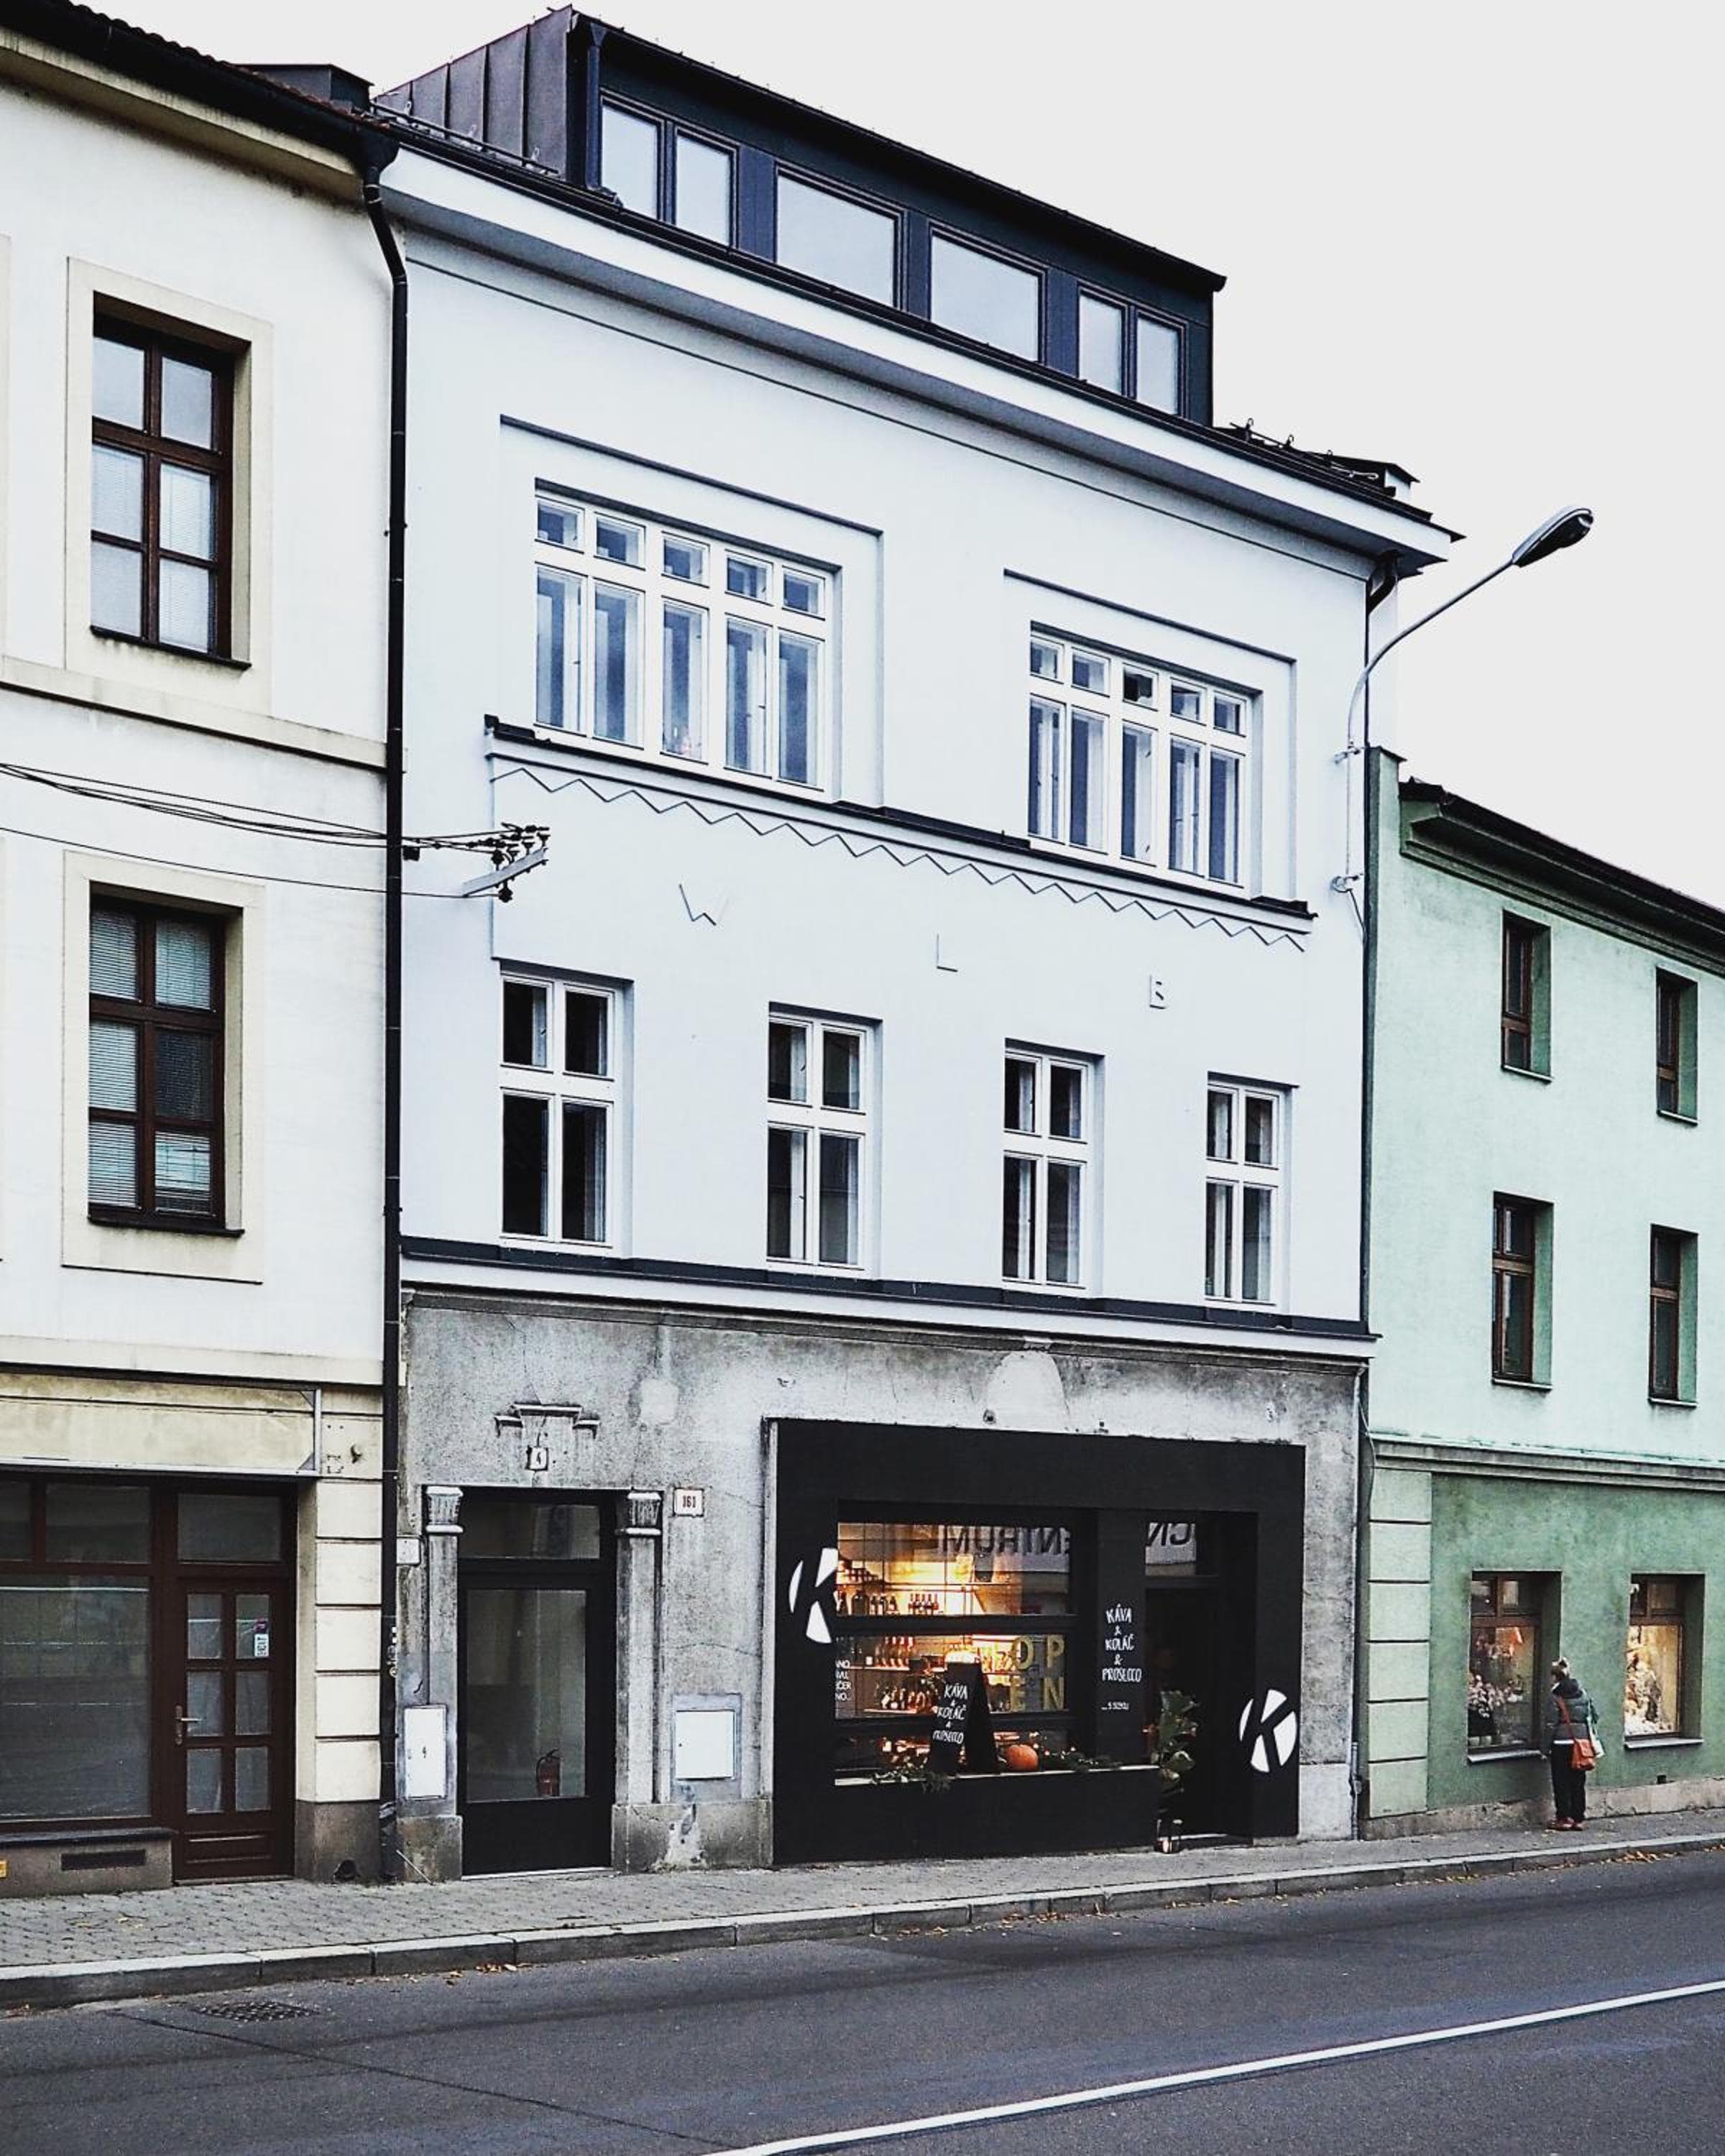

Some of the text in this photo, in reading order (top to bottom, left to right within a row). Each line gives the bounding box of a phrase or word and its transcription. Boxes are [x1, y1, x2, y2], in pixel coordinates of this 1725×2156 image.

[682, 1495, 696, 1508] 161
[1106, 1603, 1132, 1623] KÁVA
[1105, 1634, 1134, 1651] KOLÁČ
[1114, 1654, 1123, 1665] &
[1102, 1668, 1142, 1682] PROSECCO
[944, 1682, 968, 1700] KÁVA
[1238, 1688, 1297, 1773] K
